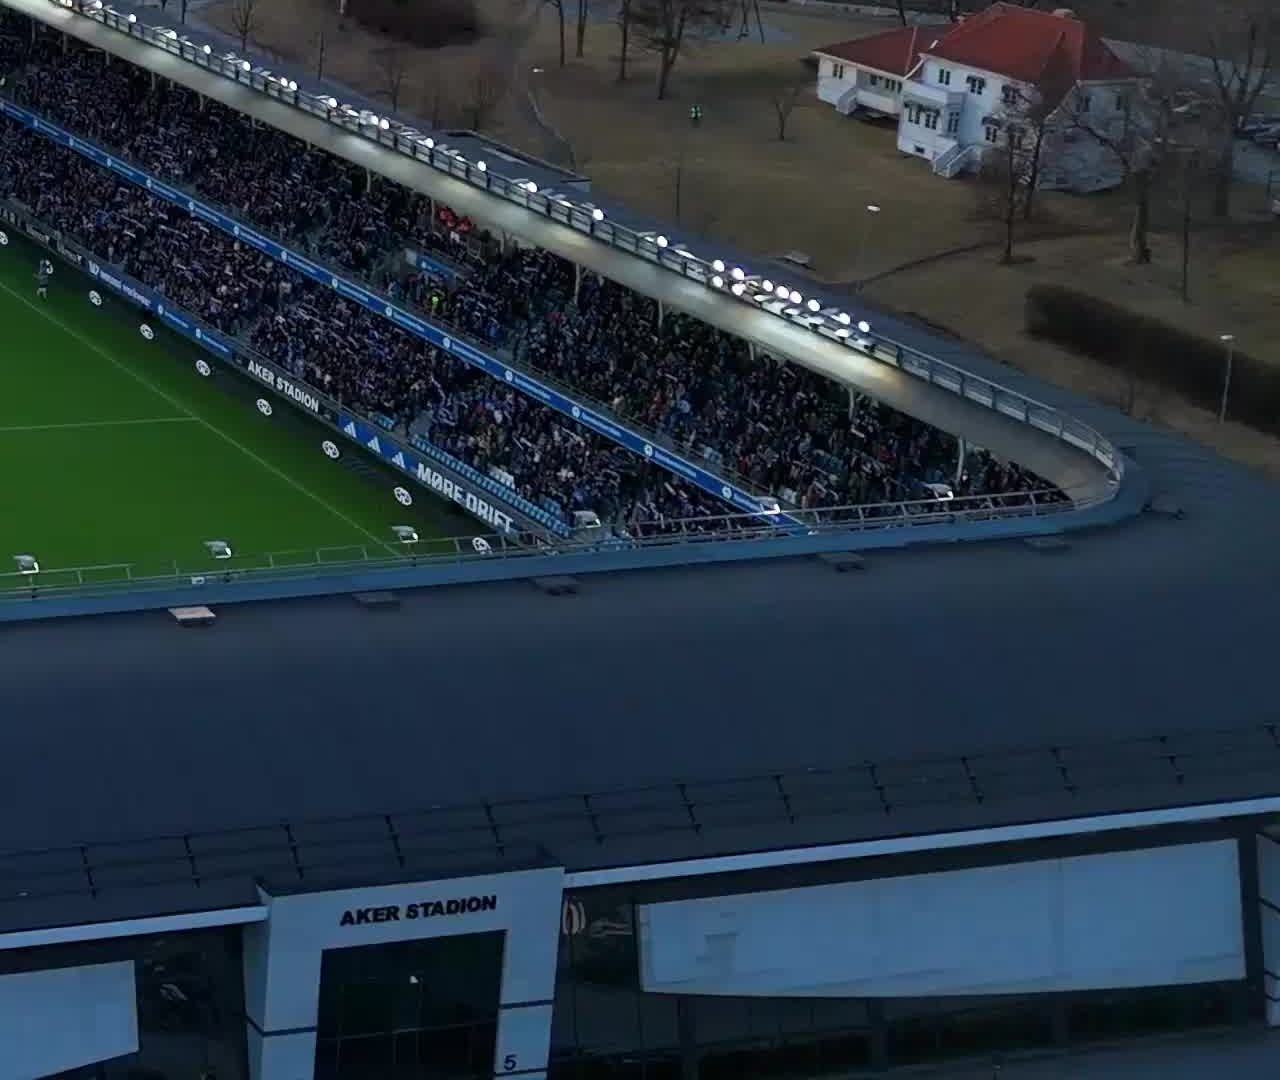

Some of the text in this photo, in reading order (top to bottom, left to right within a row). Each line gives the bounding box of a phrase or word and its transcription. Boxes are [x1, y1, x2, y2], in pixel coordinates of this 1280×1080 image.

[247, 359, 320, 413] AKER STADION
[417, 462, 516, 534] MØRE DRIFT
[340, 895, 497, 927] AKER STADION
[503, 1054, 517, 1072] 5
